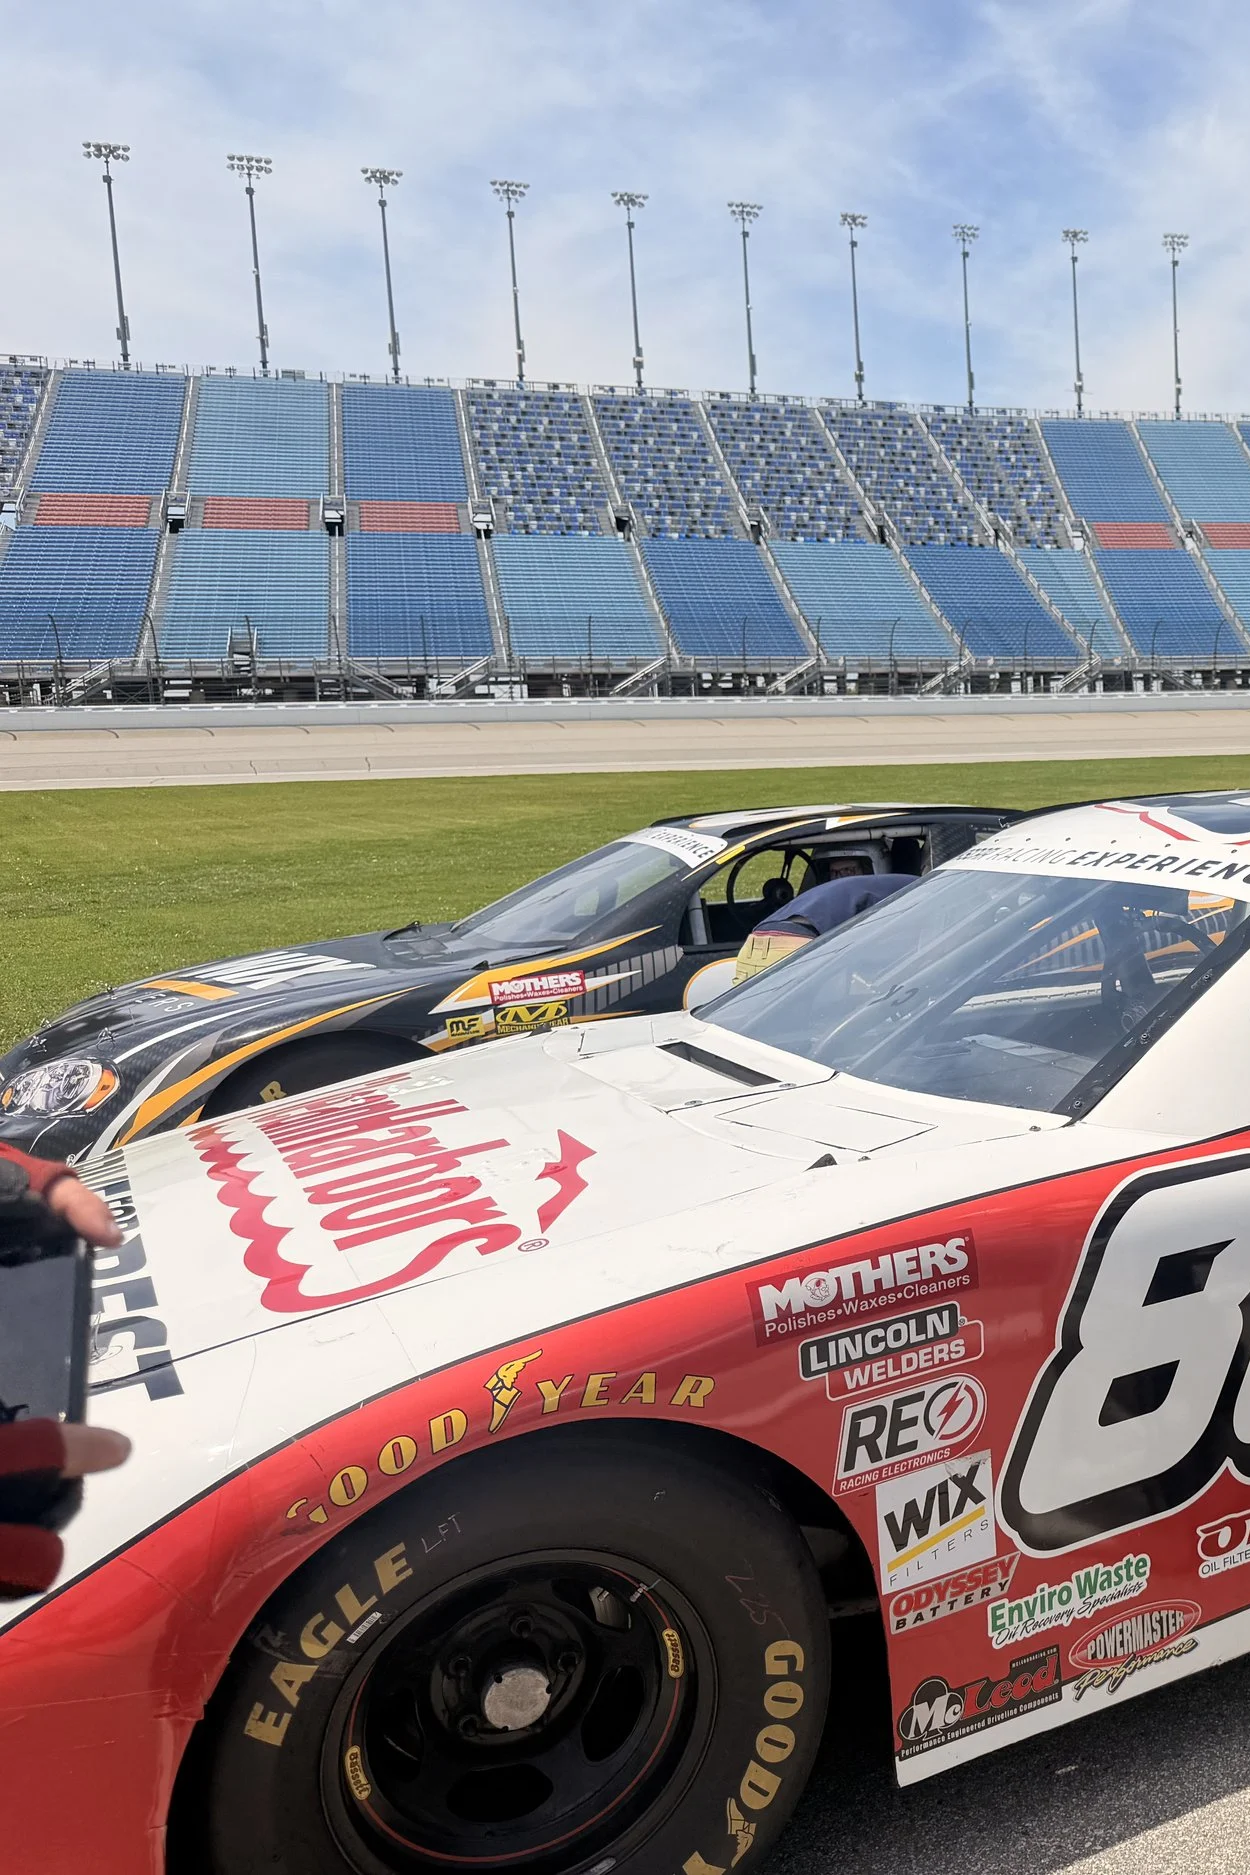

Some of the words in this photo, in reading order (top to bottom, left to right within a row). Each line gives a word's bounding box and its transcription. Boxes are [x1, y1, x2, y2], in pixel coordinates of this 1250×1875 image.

[493, 973, 582, 996] MOTHERS
[758, 1237, 969, 1321] MOTHERS
[810, 1310, 950, 1372] LINCOLN
[844, 1339, 966, 1389] WELDERS
[840, 1471, 879, 1492] RACING
[882, 1448, 950, 1477] ELECTRONICS
[884, 1463, 986, 1553] WIX
[889, 1519, 989, 1587] FILTERS
[1201, 1559, 1220, 1575] OIL
[892, 1554, 1018, 1617] ODYSSEY
[895, 1579, 1009, 1631] BATTERY
[990, 1584, 1072, 1632] Enviro
[1075, 1556, 1148, 1598] Waste
[245, 1542, 413, 1746] EAGLE
[1087, 1610, 1186, 1660] POWERMASTER
[908, 1656, 1058, 1739] McLeod
[1073, 1639, 1197, 1702] Performance
[901, 1735, 946, 1758] Performance
[947, 1719, 986, 1740] Engineered
[987, 1706, 1018, 1728] Driveline
[1019, 1692, 1059, 1714] Components
